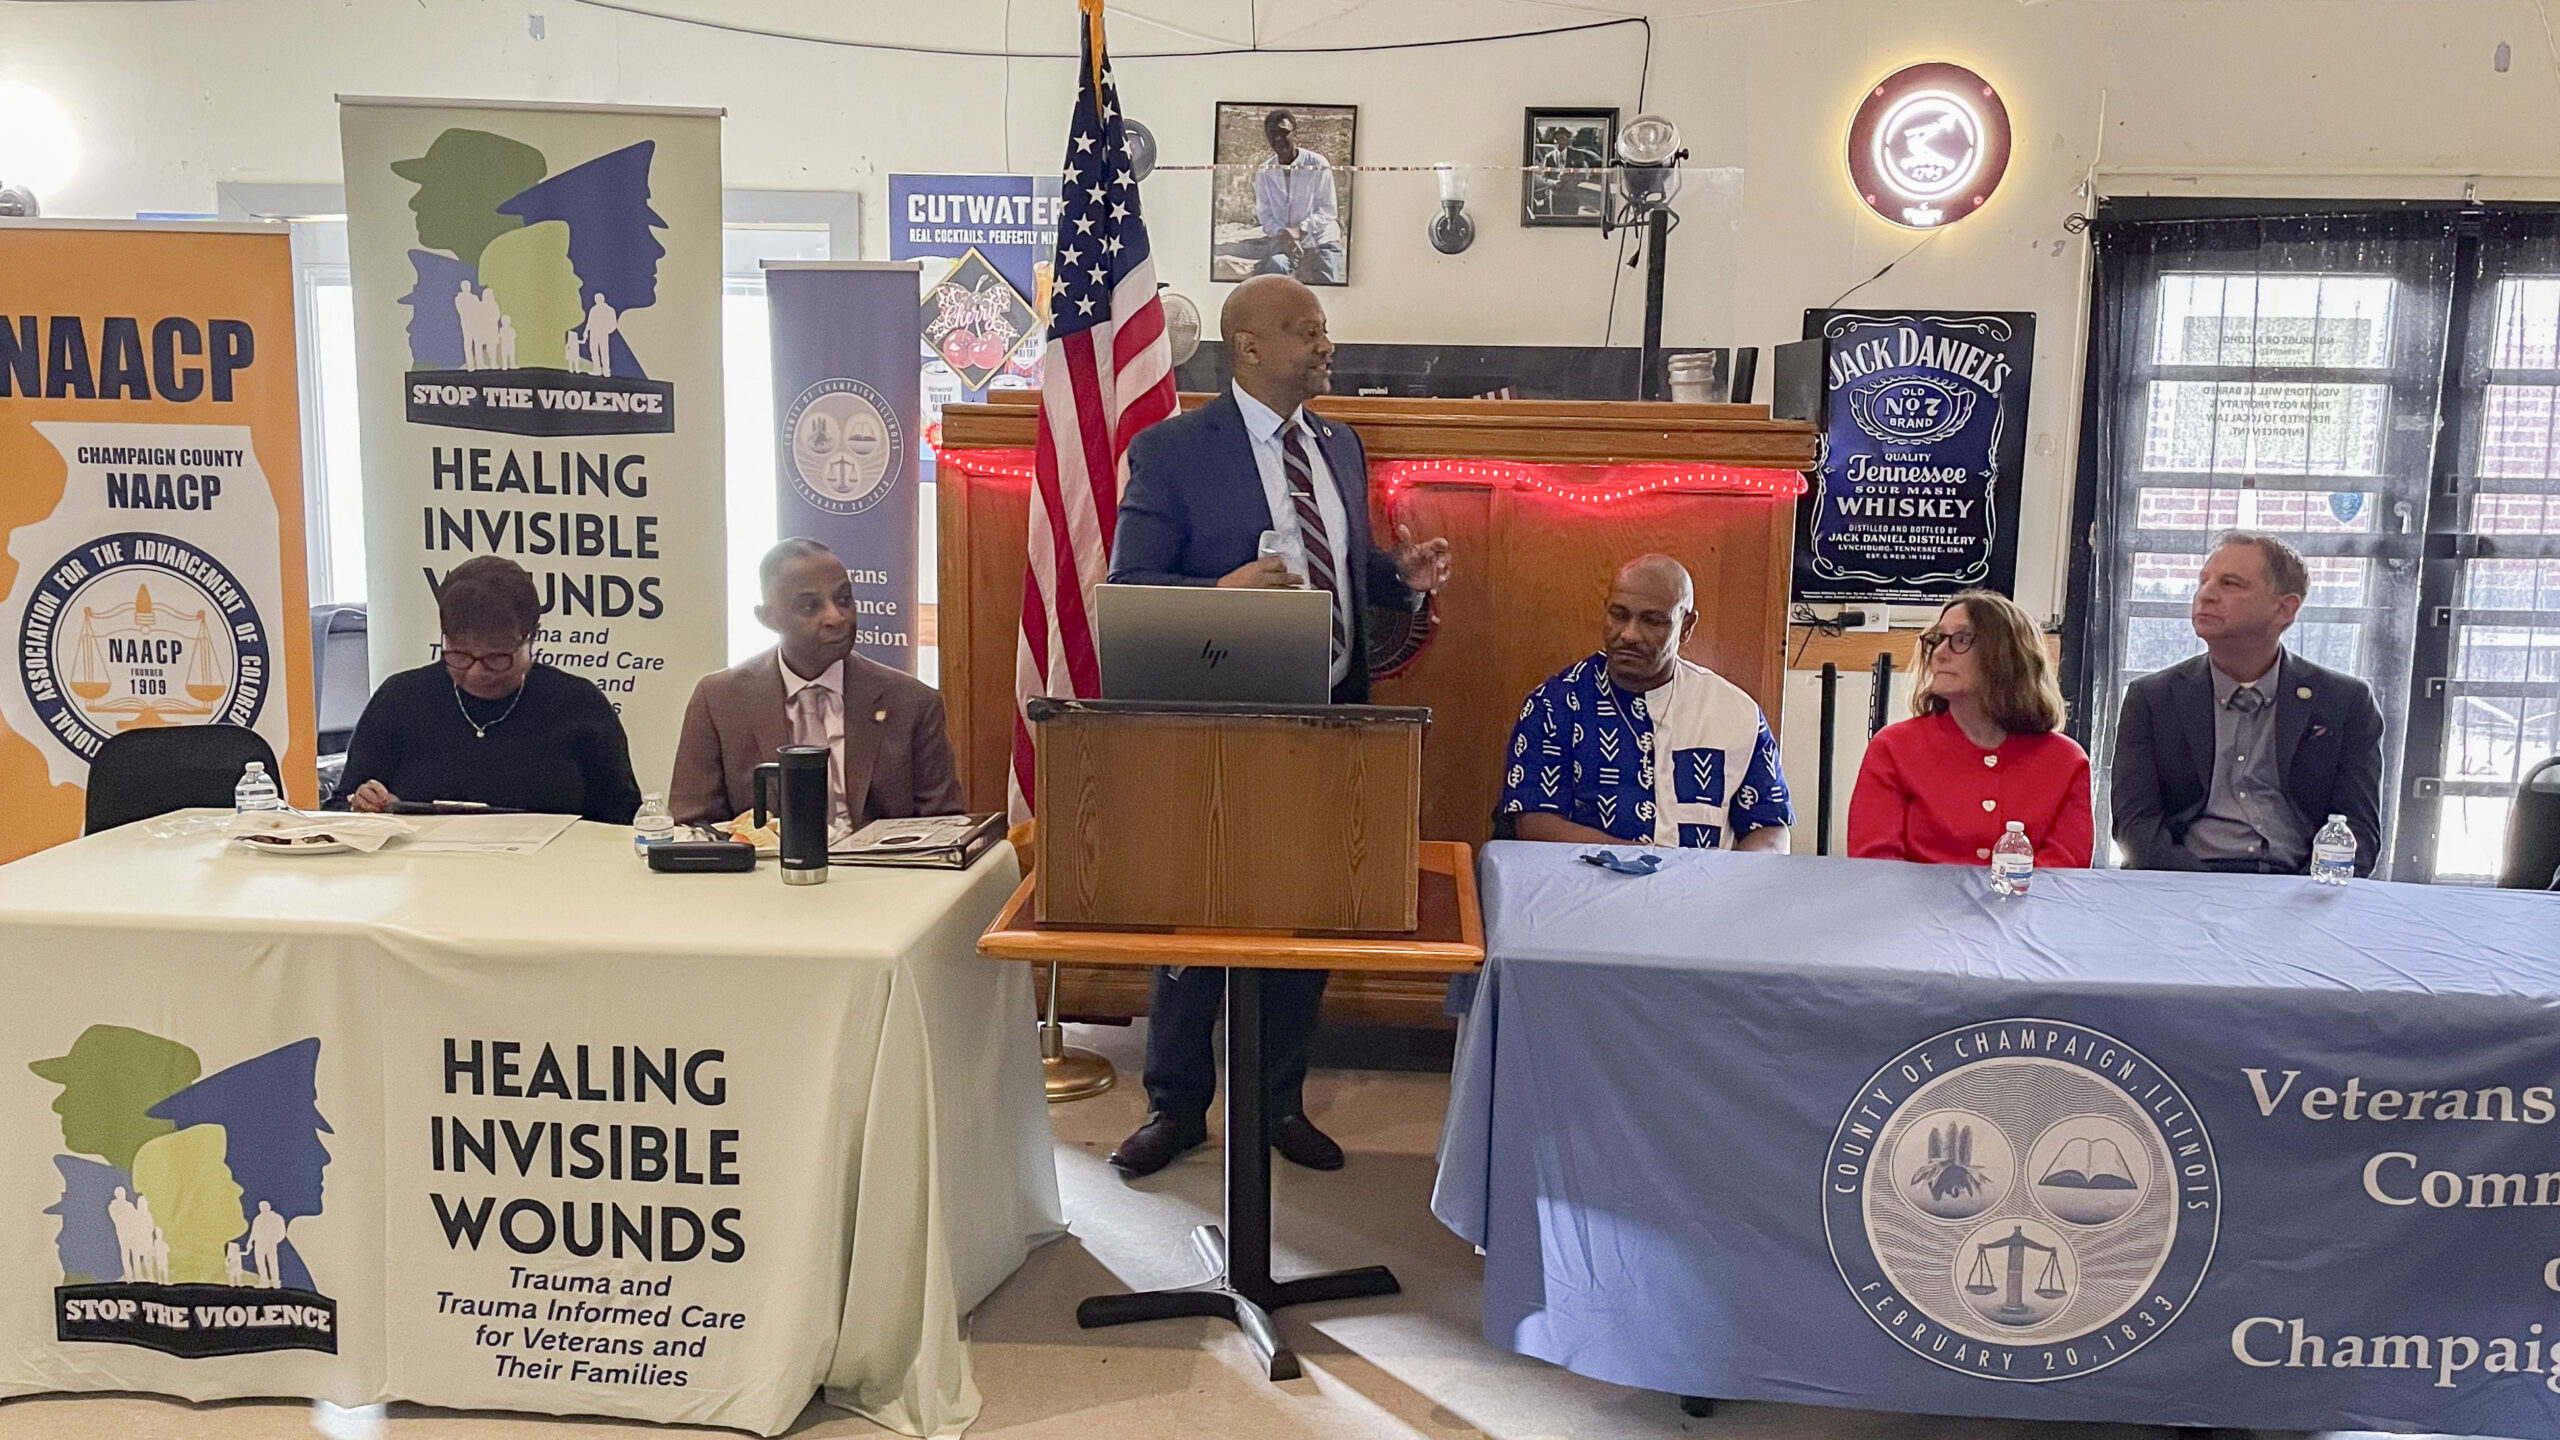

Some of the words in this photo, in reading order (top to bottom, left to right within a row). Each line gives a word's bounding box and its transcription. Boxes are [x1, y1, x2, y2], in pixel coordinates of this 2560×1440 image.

[909, 228, 933, 243] REAL
[935, 228, 986, 244] COCKTAILS.
[989, 230, 1037, 245] PERFECTLY
[1041, 231, 1058, 245] MIX
[944, 299, 1001, 331] Cherry
[0, 315, 255, 402] NAACP
[1829, 337, 1894, 391] JACK
[1898, 327, 2012, 394] DANIEL'S
[412, 384, 477, 406] STOP
[483, 386, 533, 410] THE
[538, 389, 664, 414] VIOLENCE
[1358, 386, 1389, 396] gemini
[1902, 388, 1925, 396] OLD
[1925, 398, 1942, 416] 7
[1889, 418, 1933, 429] BRAND
[77, 446, 176, 466] CHAMPAIGN
[180, 448, 244, 467] COUNTY
[1847, 454, 1967, 484] Tennessee
[1884, 453, 1932, 463] QUALITY
[431, 446, 648, 498] HEALING
[106, 472, 221, 511] NAACP
[1855, 486, 1900, 495] SOUR
[1907, 487, 1957, 496] MASH
[1836, 497, 1975, 518] WHISKEY
[423, 506, 660, 560] INVISIBLE
[1828, 533, 1859, 542] JACK
[1862, 534, 1906, 544] DANIEL
[1909, 535, 1976, 545] DISTILLERY
[1890, 525, 1908, 533] AND
[1910, 526, 1945, 534] BOTTLED
[1948, 526, 1958, 534] BY
[90, 541, 124, 567] THE
[53, 559, 89, 591] FOR
[135, 540, 245, 614] ADVANCEMENT
[846, 569, 888, 585] rans
[423, 567, 664, 619] UNDS
[25, 590, 61, 702] ASSOCIATION
[235, 622, 258, 643] OF
[569, 627, 609, 644] and
[855, 625, 908, 647] ssion
[109, 638, 182, 664] NAACP
[534, 648, 609, 668] formed
[617, 651, 665, 671] Care
[1201, 640, 1228, 669] hp
[130, 679, 166, 695] 1909
[131, 668, 163, 677] FOUNDED
[597, 676, 635, 692] and
[228, 655, 262, 726] COLORED
[50, 706, 103, 758] TIONAL
[442, 1037, 727, 1106] HEALING
[2241, 1068, 2557, 1125] Veterans
[1834, 1088, 1891, 1195] COUNTY
[1901, 1052, 1940, 1082] OF
[430, 1115, 741, 1186] INVISIBLE
[428, 1192, 746, 1264] WOUNDS
[509, 1267, 610, 1296] Trauma
[619, 1273, 671, 1298] and
[65, 1298, 136, 1323] STOP
[142, 1300, 190, 1328] THE
[198, 1302, 331, 1333] VIOLENCE
[436, 1292, 538, 1321] Trauma
[547, 1298, 671, 1328] Informed
[680, 1304, 746, 1331] Care
[1862, 1281, 2013, 1370] FEBRUARY
[475, 1325, 515, 1349] for
[522, 1327, 645, 1355] Veterans
[653, 1335, 707, 1359] and
[2231, 1317, 2560, 1394] Champai
[494, 1355, 563, 1380] Their
[570, 1360, 689, 1388] Families
